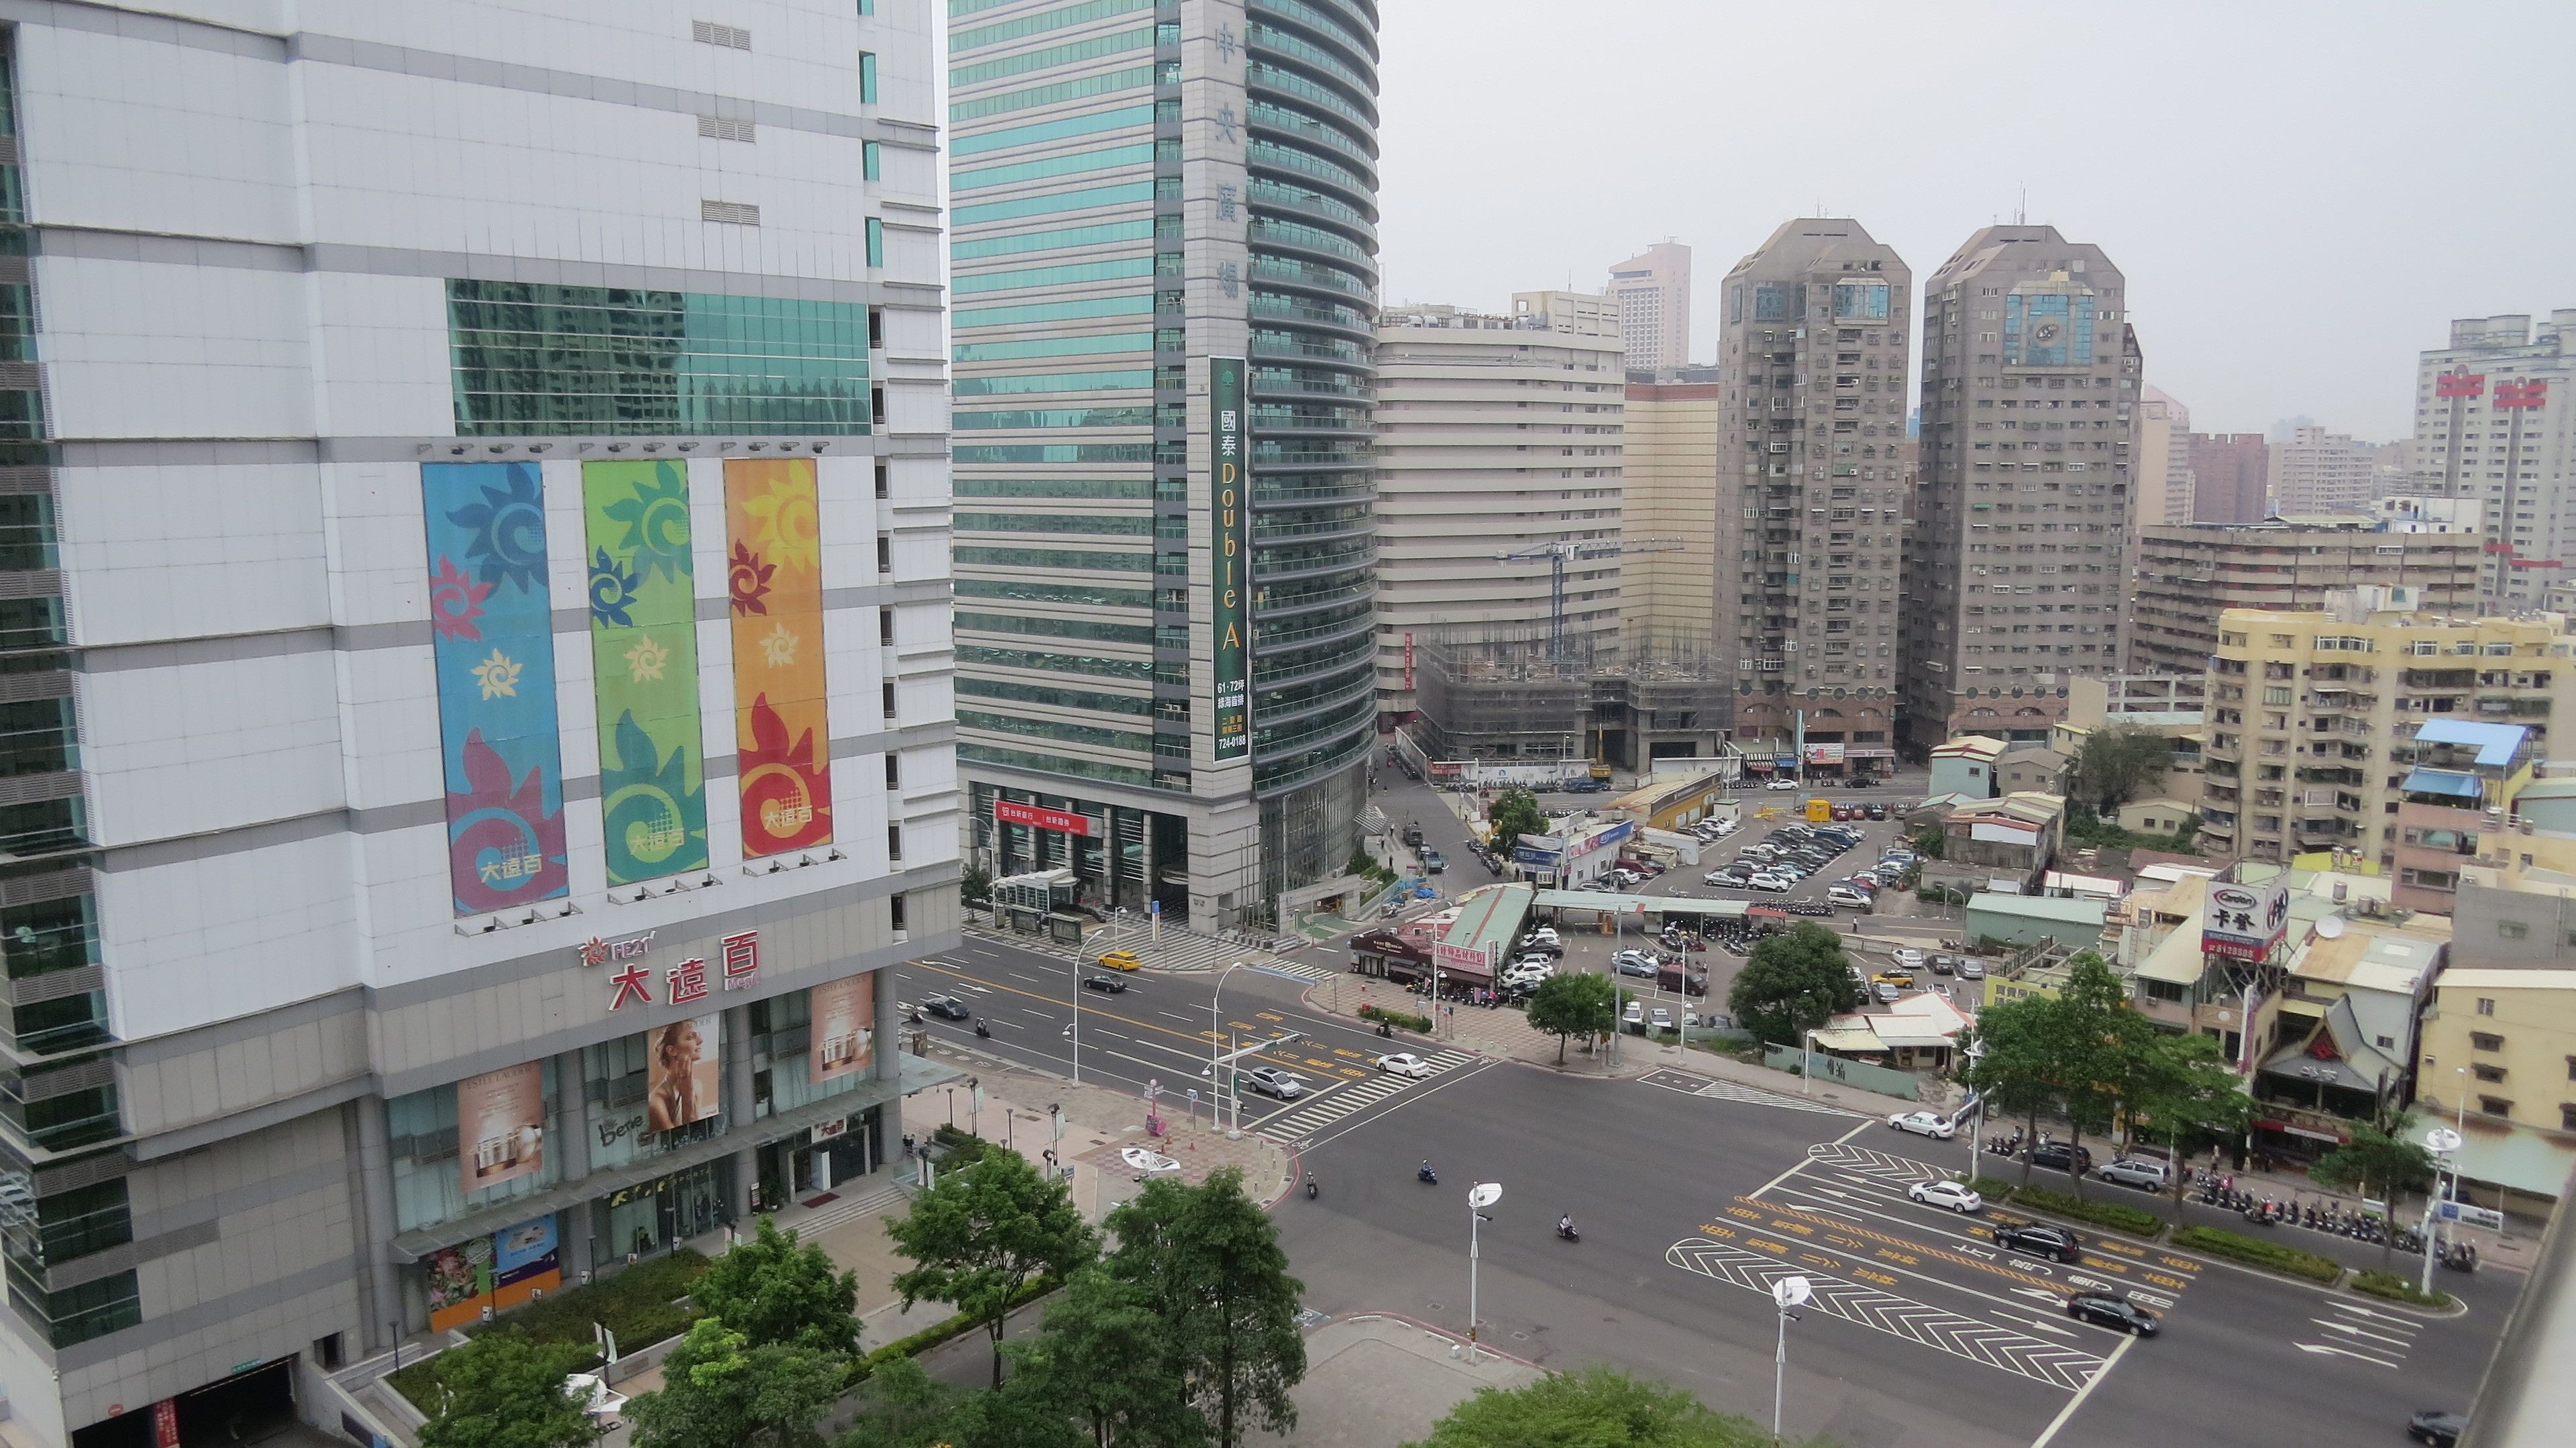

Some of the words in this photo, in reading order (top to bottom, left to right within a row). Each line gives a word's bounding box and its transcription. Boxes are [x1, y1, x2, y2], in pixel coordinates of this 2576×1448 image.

[1215, 21, 1239, 299] 中央廣場
[1220, 409, 1237, 456] 國泰
[1221, 462, 1238, 609] Double
[1222, 622, 1240, 651] A
[763, 805, 813, 831] 大遠百
[480, 854, 543, 883] 大遠百
[608, 929, 759, 1011] 大遠百
